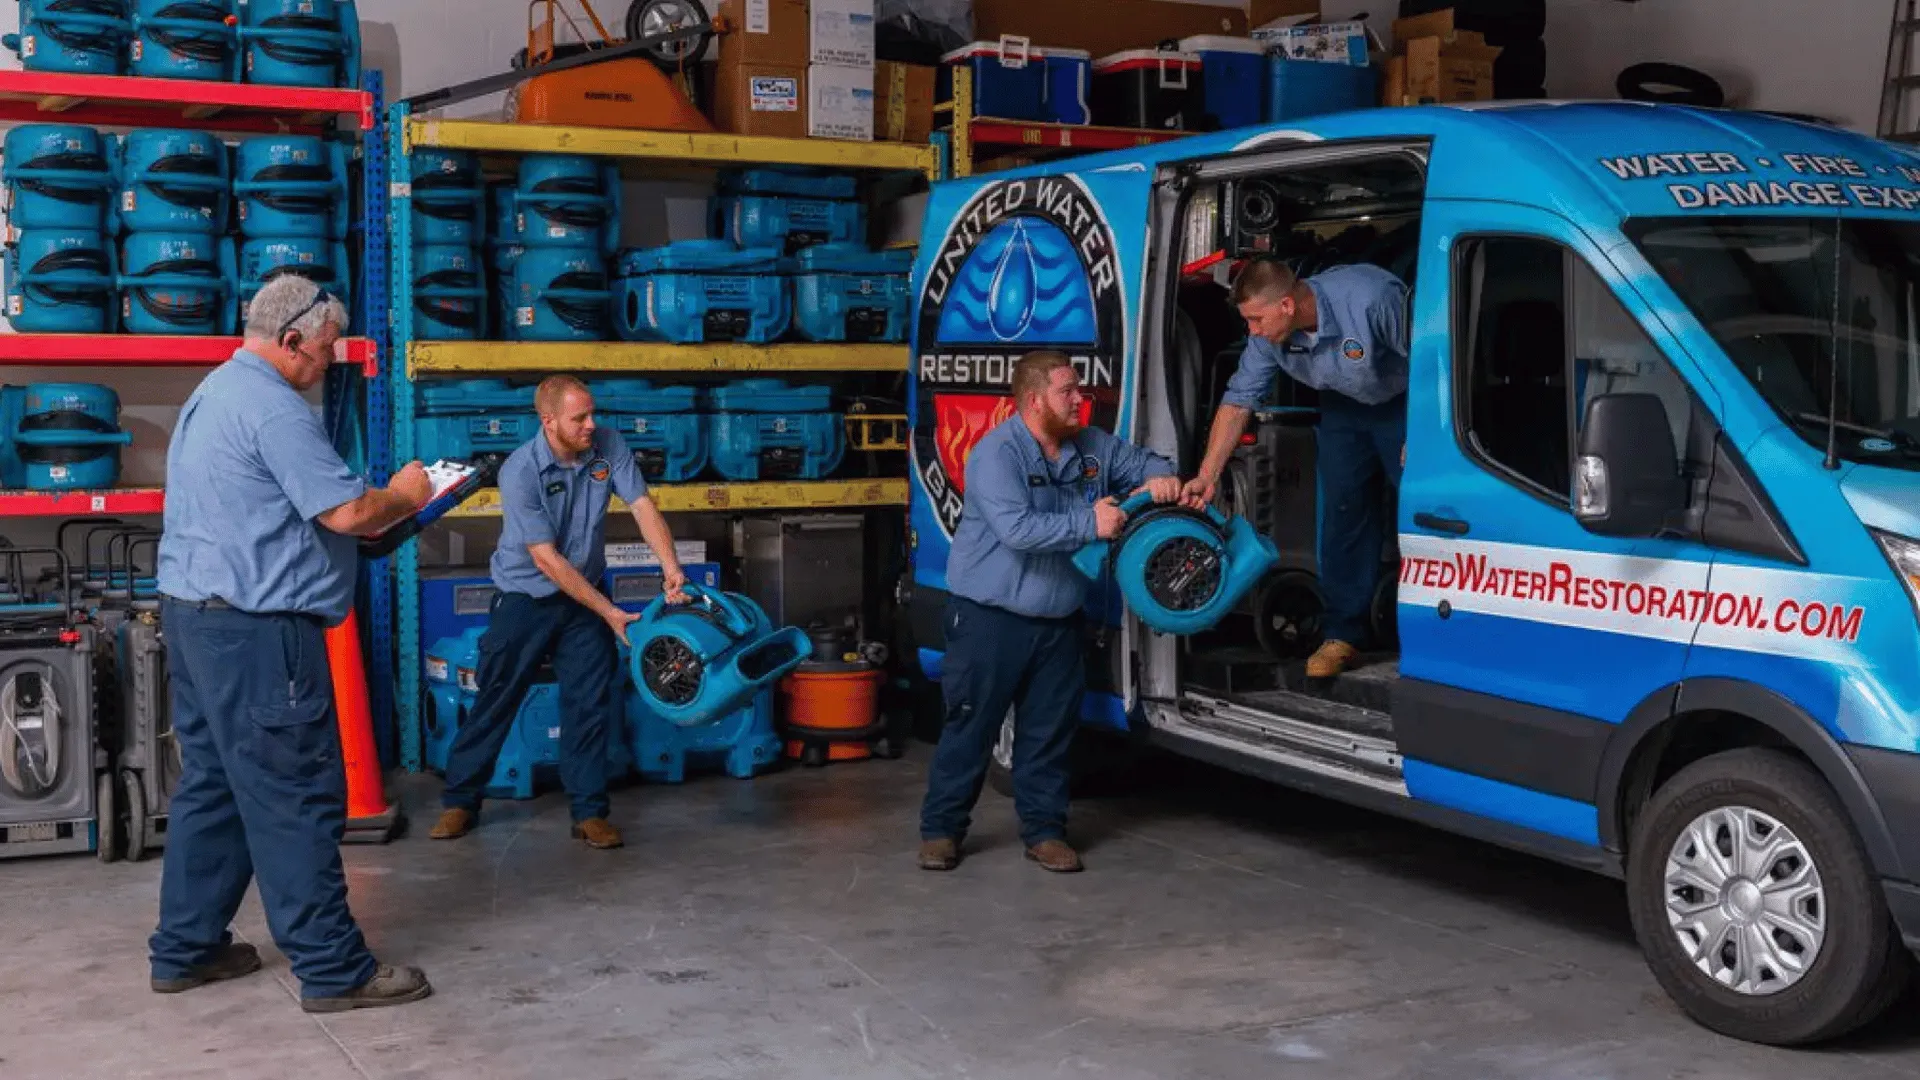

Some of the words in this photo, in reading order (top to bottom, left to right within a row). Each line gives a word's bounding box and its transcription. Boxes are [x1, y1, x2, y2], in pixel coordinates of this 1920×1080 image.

[1601, 153, 1747, 179] WATER
[1783, 154, 1867, 177] FIRE
[1668, 182, 1850, 208] DAMAGE
[1849, 185, 1920, 210] EXP
[928, 181, 1026, 304] UNITED
[1036, 178, 1114, 297] WATER
